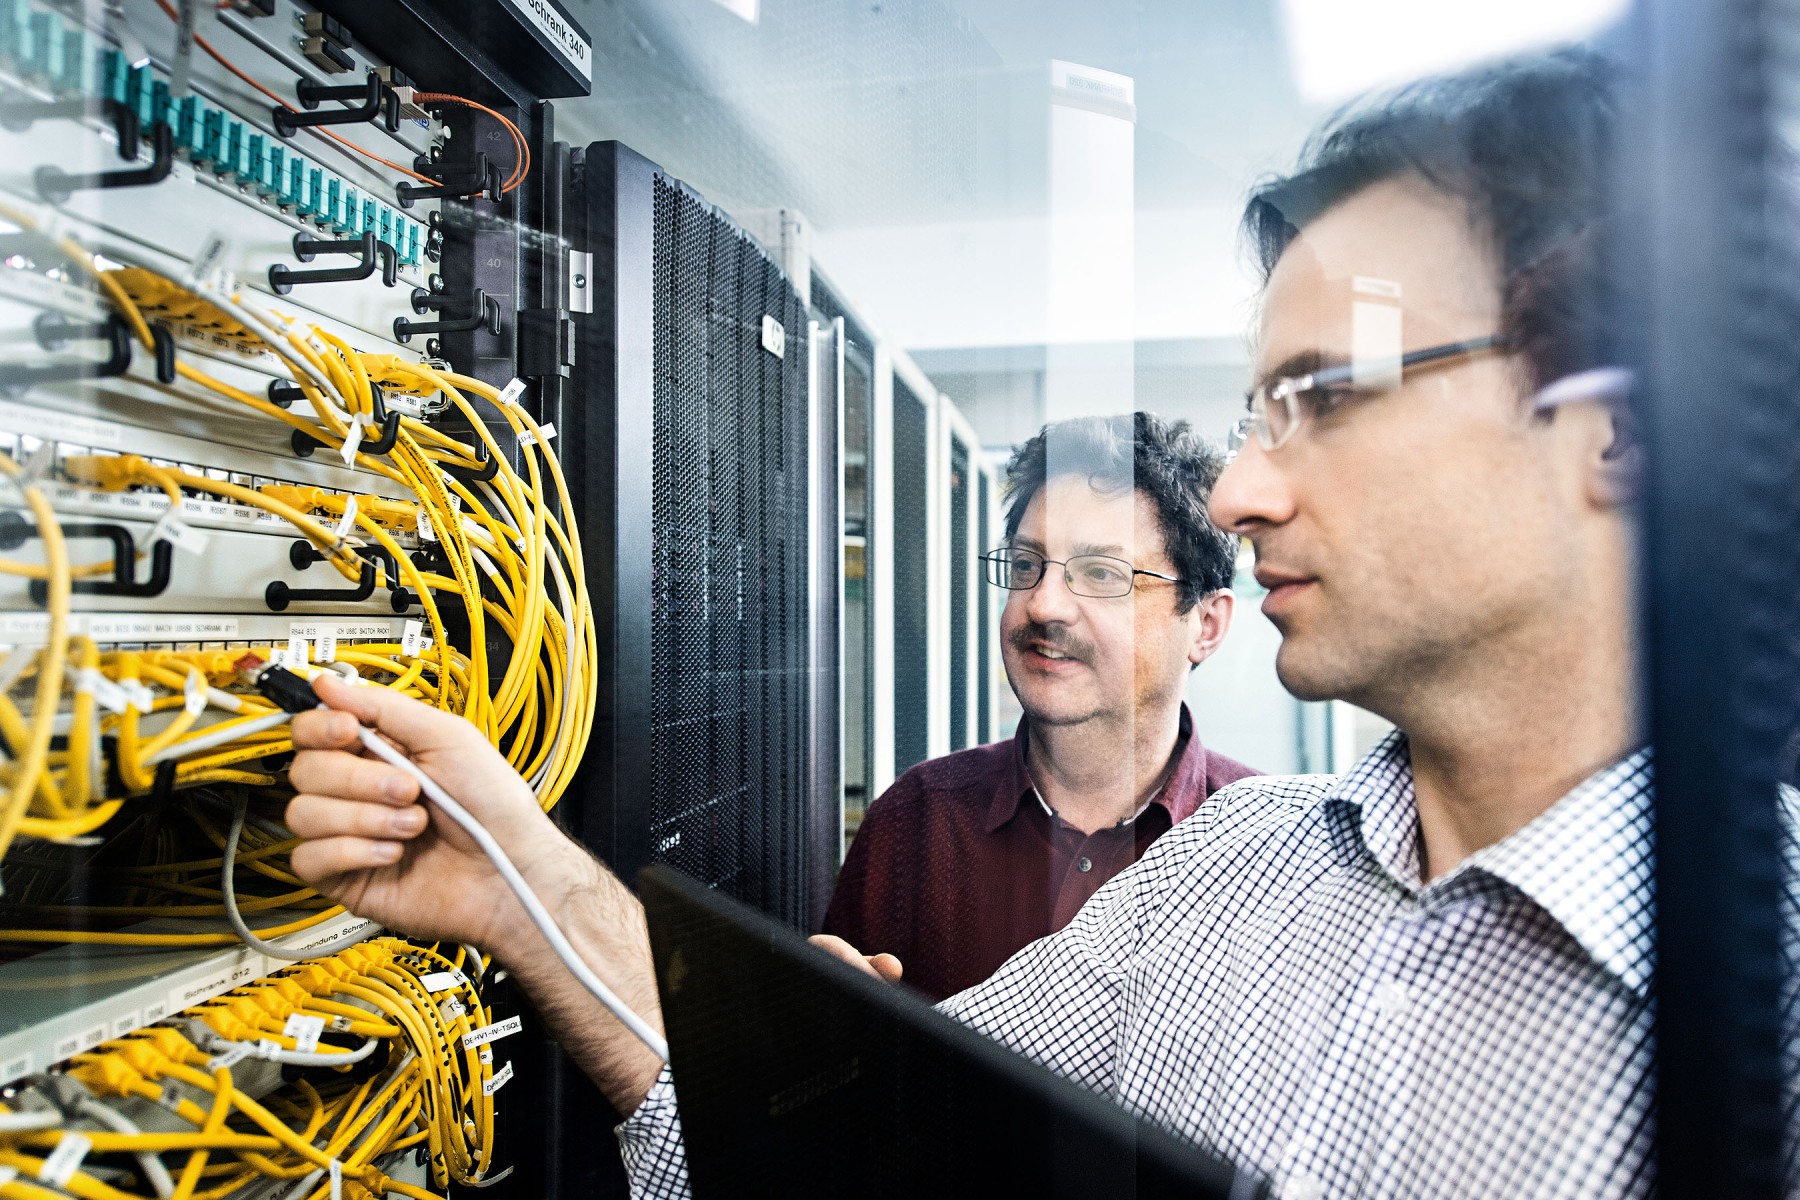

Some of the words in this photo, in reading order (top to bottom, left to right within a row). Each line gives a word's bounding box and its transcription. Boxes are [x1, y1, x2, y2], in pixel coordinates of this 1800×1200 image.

[528, 0, 567, 43] Schrank
[569, 34, 584, 60] 340
[486, 131, 501, 142] 42
[486, 258, 501, 269] 40
[306, 628, 317, 636] BIS
[359, 627, 376, 635] SWITCH
[183, 978, 227, 1001] Schrank
[231, 967, 251, 981] 012
